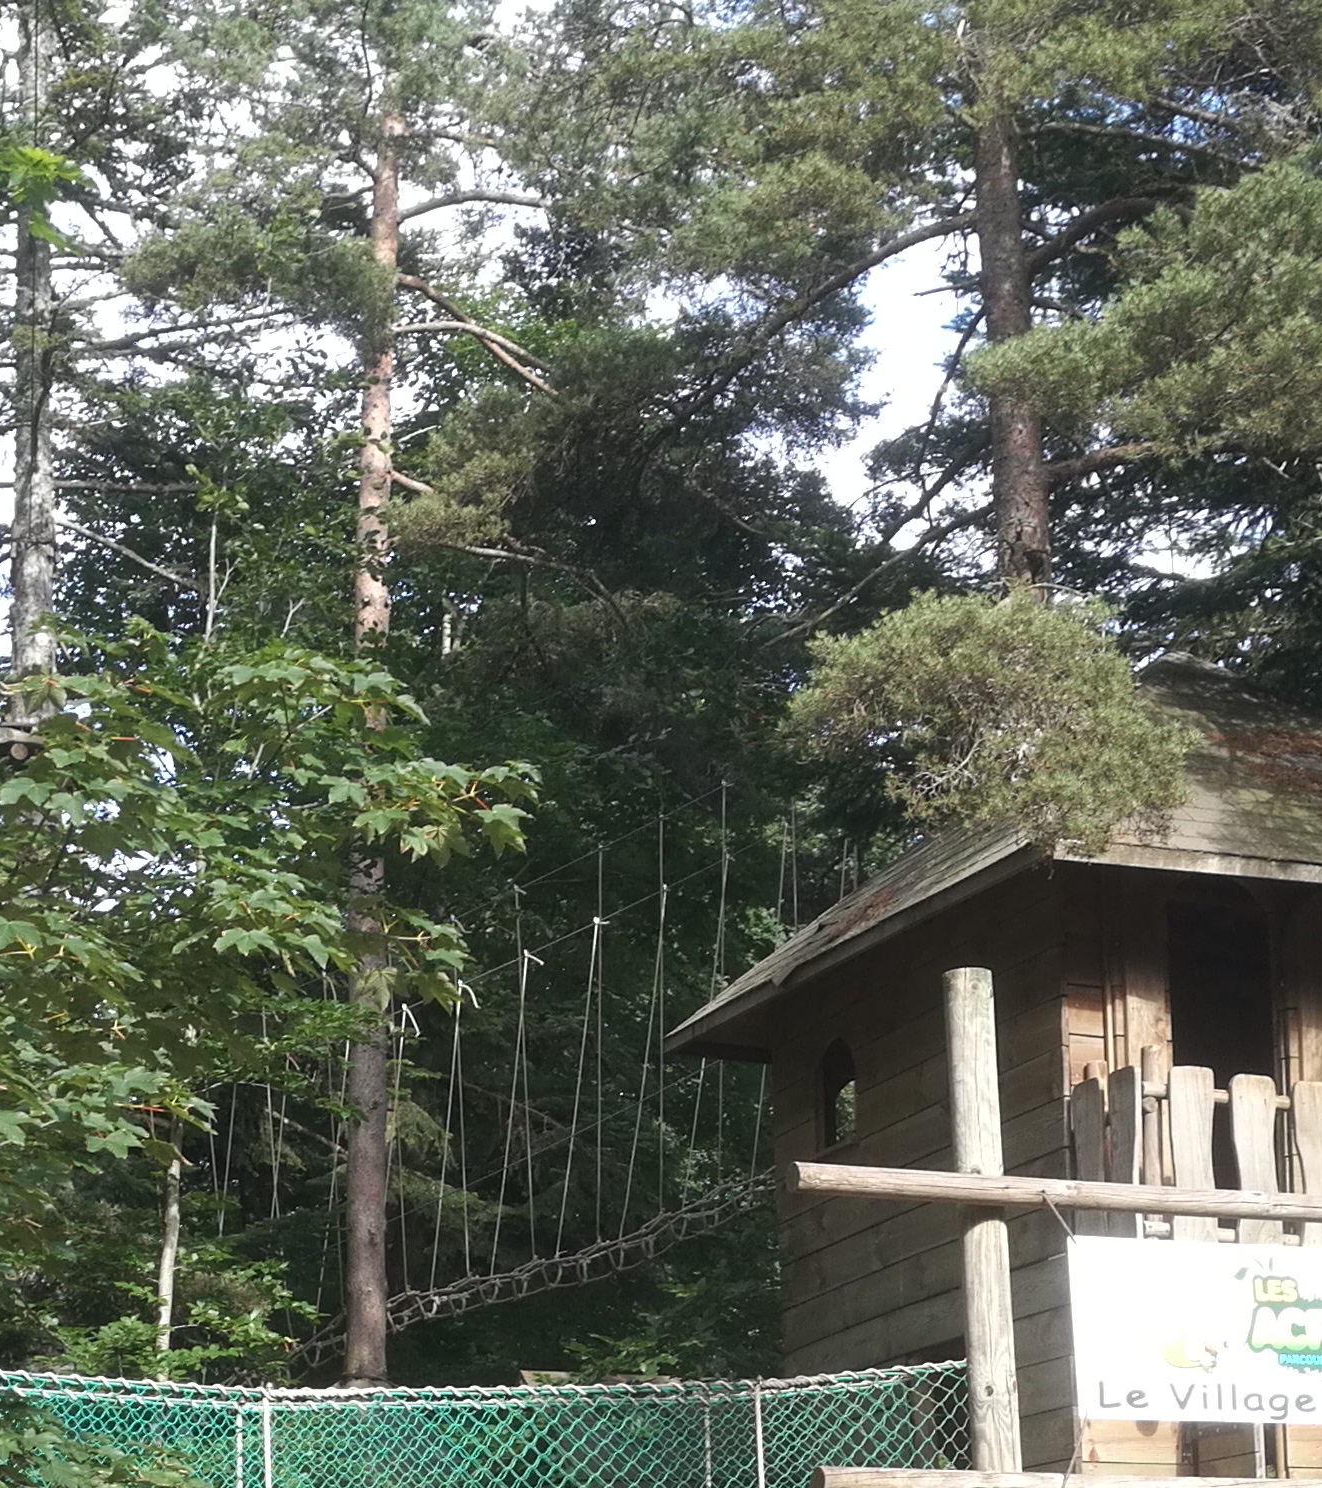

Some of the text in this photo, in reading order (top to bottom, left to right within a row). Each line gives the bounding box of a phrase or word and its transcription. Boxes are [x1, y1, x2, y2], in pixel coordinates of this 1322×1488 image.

[1253, 1277, 1298, 1303] LES
[1098, 1380, 1150, 1409] Le
[1169, 1382, 1317, 1421] Village
